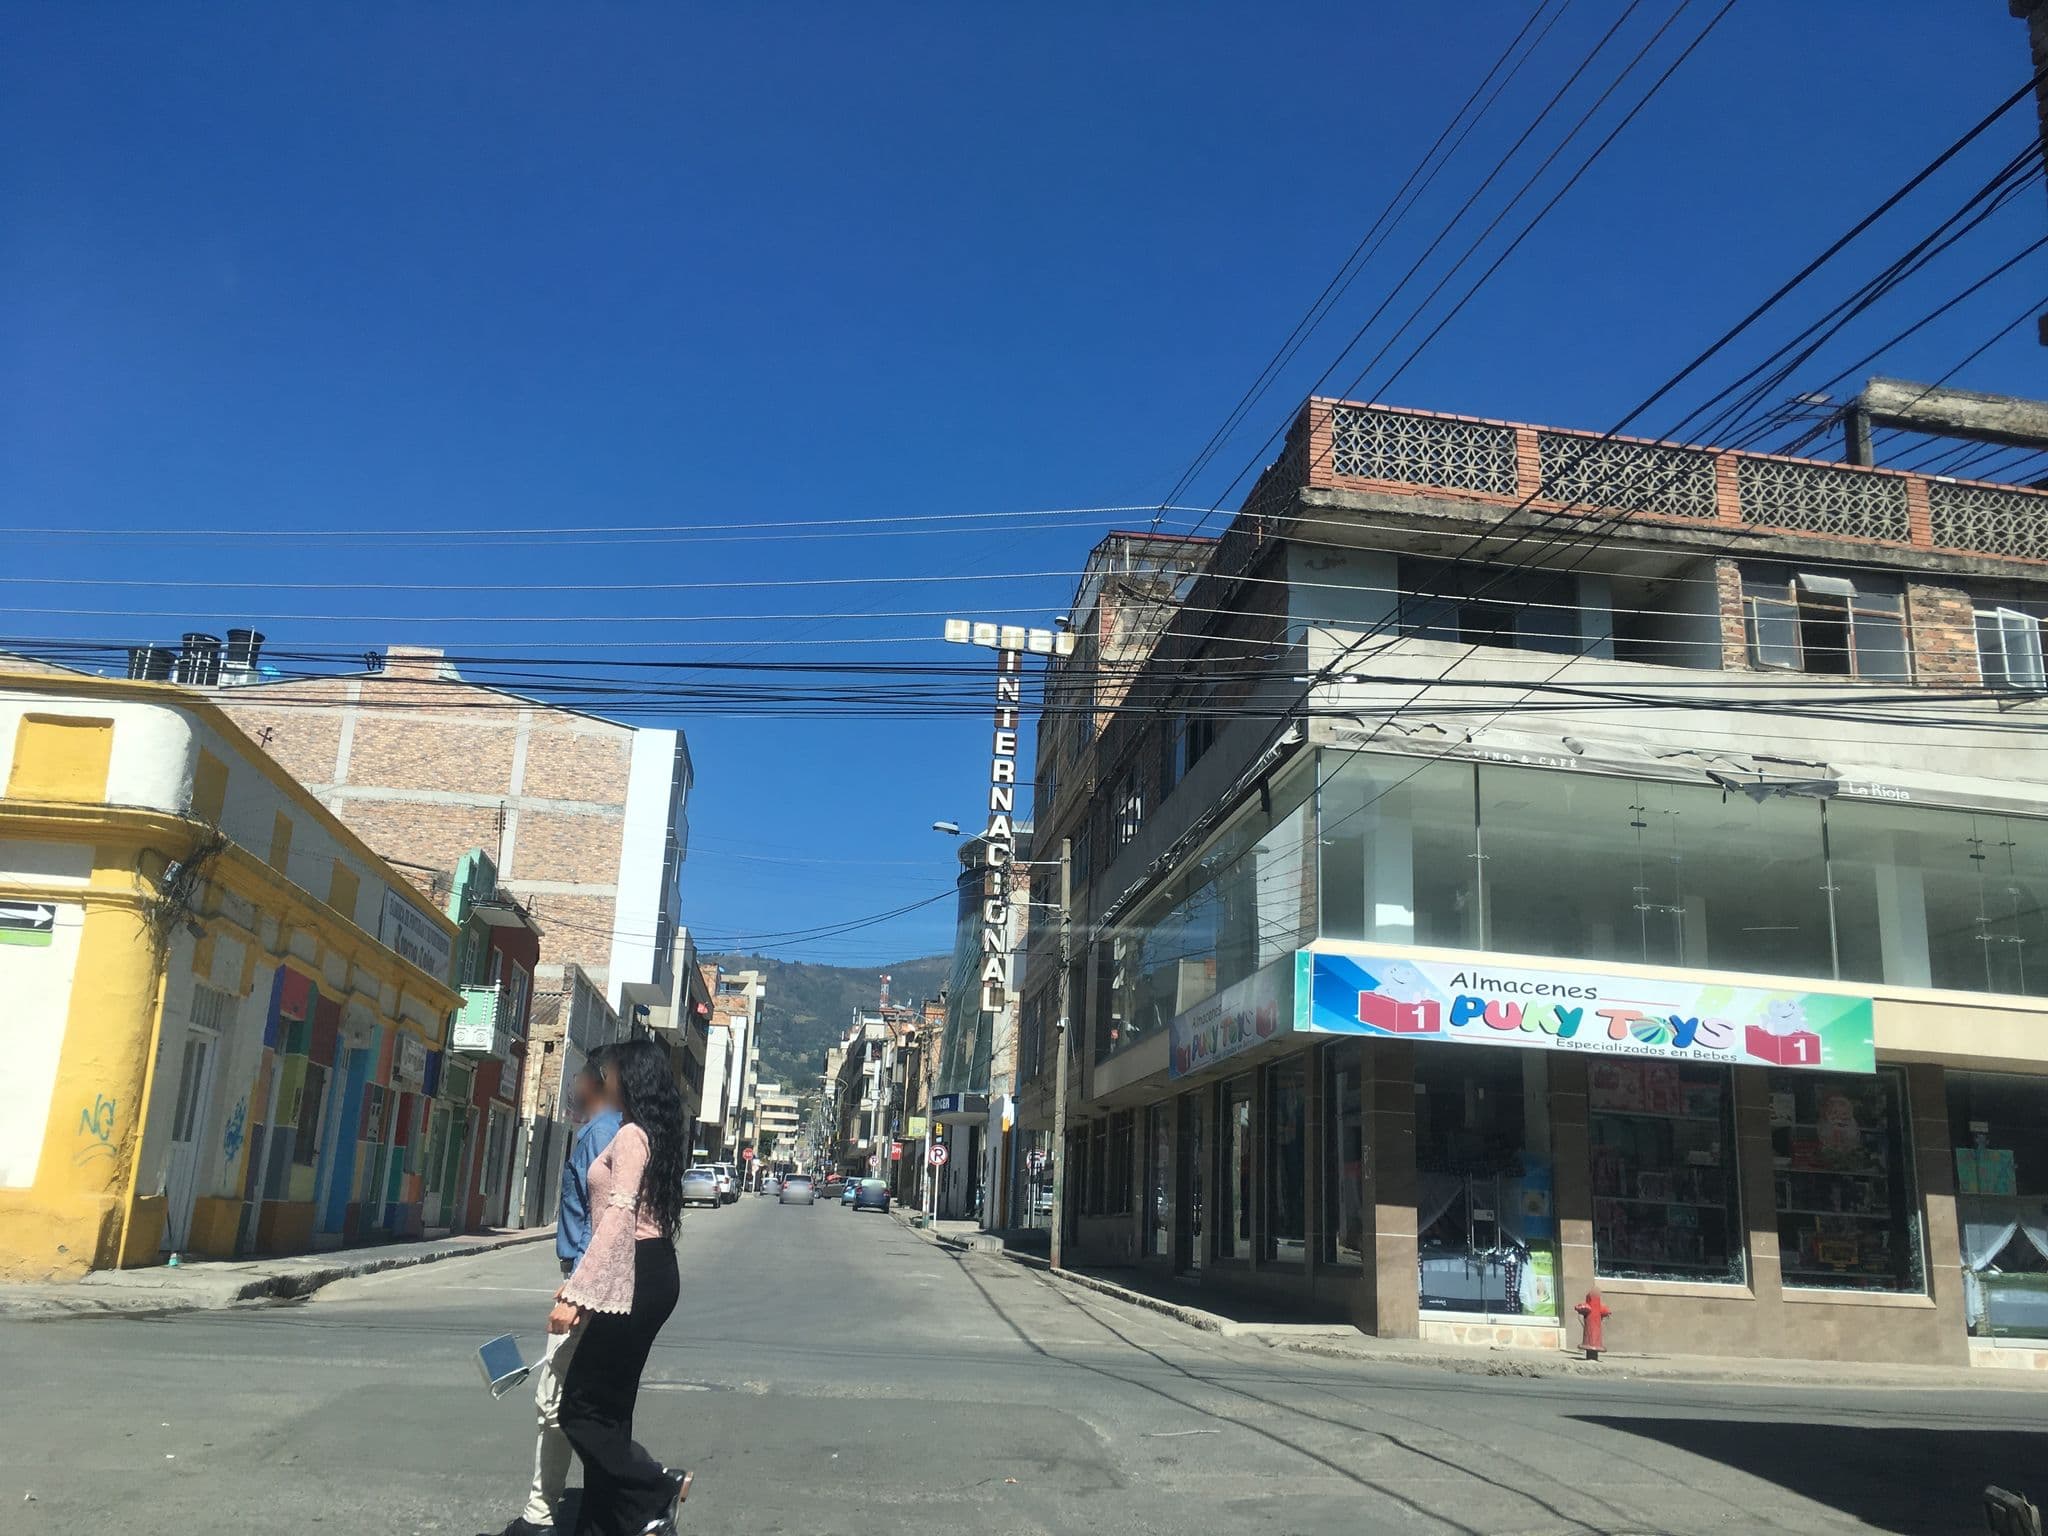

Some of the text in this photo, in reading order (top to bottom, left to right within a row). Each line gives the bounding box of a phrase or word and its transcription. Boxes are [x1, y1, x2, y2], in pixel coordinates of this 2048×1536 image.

[945, 619, 1074, 655] HOTEL
[1850, 781, 1911, 800] La Rioja
[981, 651, 1020, 1013] INTERNACIONAL
[1450, 972, 1598, 1000] Almacenes
[1411, 1005, 1425, 1029] 1
[1450, 994, 1736, 1050] PUKY TOYS
[1555, 1037, 1738, 1063] Especializados en Bebes
[1793, 1038, 1807, 1061] 1
